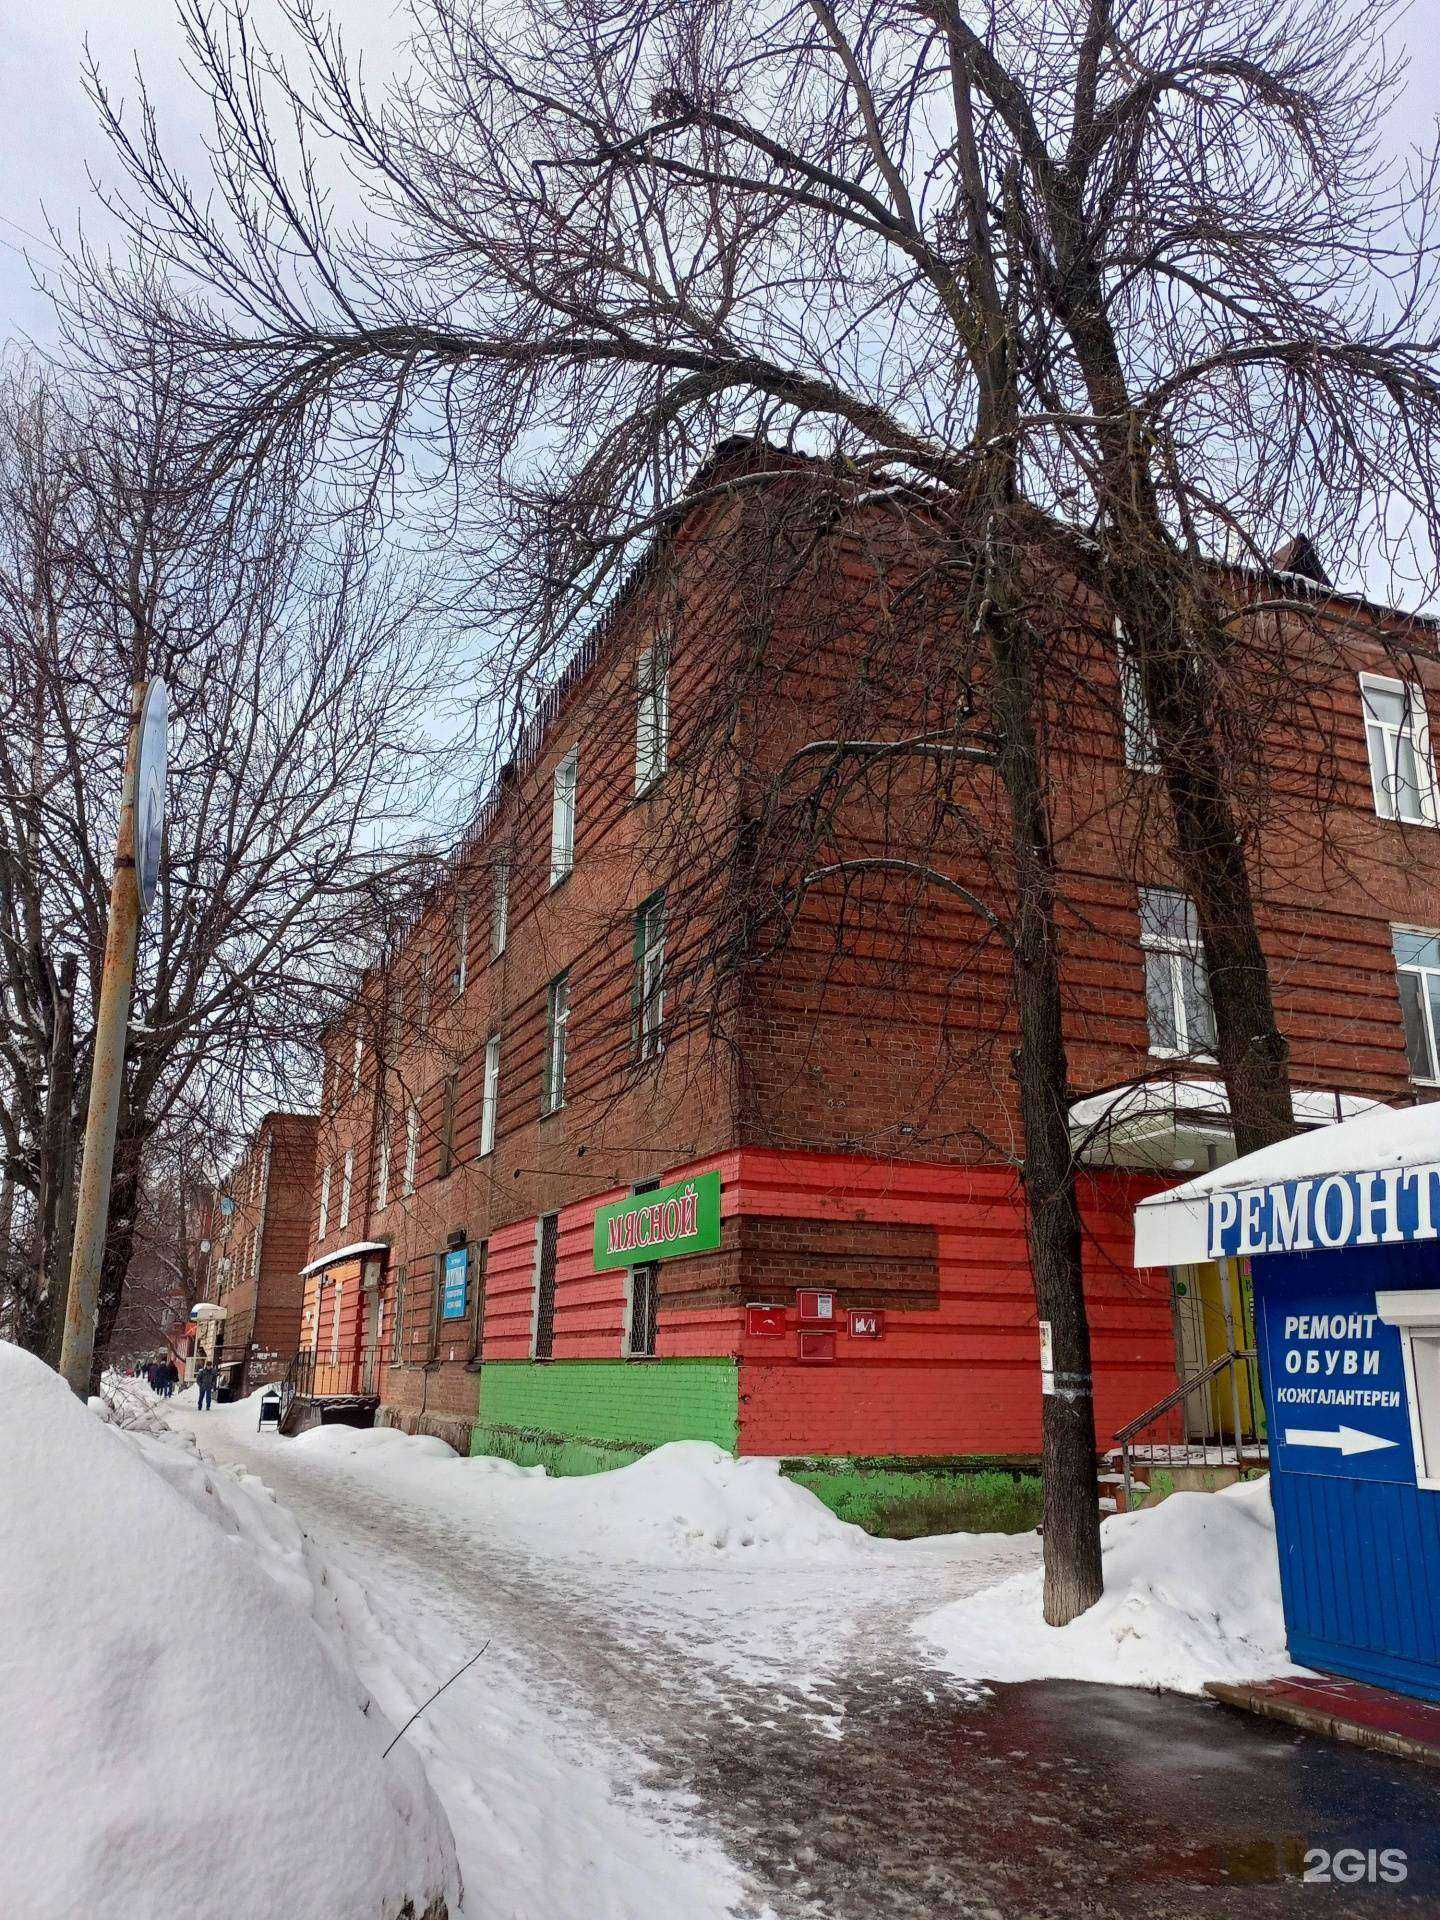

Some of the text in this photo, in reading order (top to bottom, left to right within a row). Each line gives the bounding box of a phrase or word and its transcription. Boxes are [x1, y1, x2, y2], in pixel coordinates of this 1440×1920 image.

[607, 1183, 698, 1254] МЯСНОЙ
[1209, 1162, 1440, 1258] РЕМОНТ
[1284, 1314, 1377, 1339] РЕМОНТ
[1285, 1350, 1380, 1375] ОБУВИ
[1277, 1388, 1400, 1407] КОЖГАЛАНТЕРЕИ
